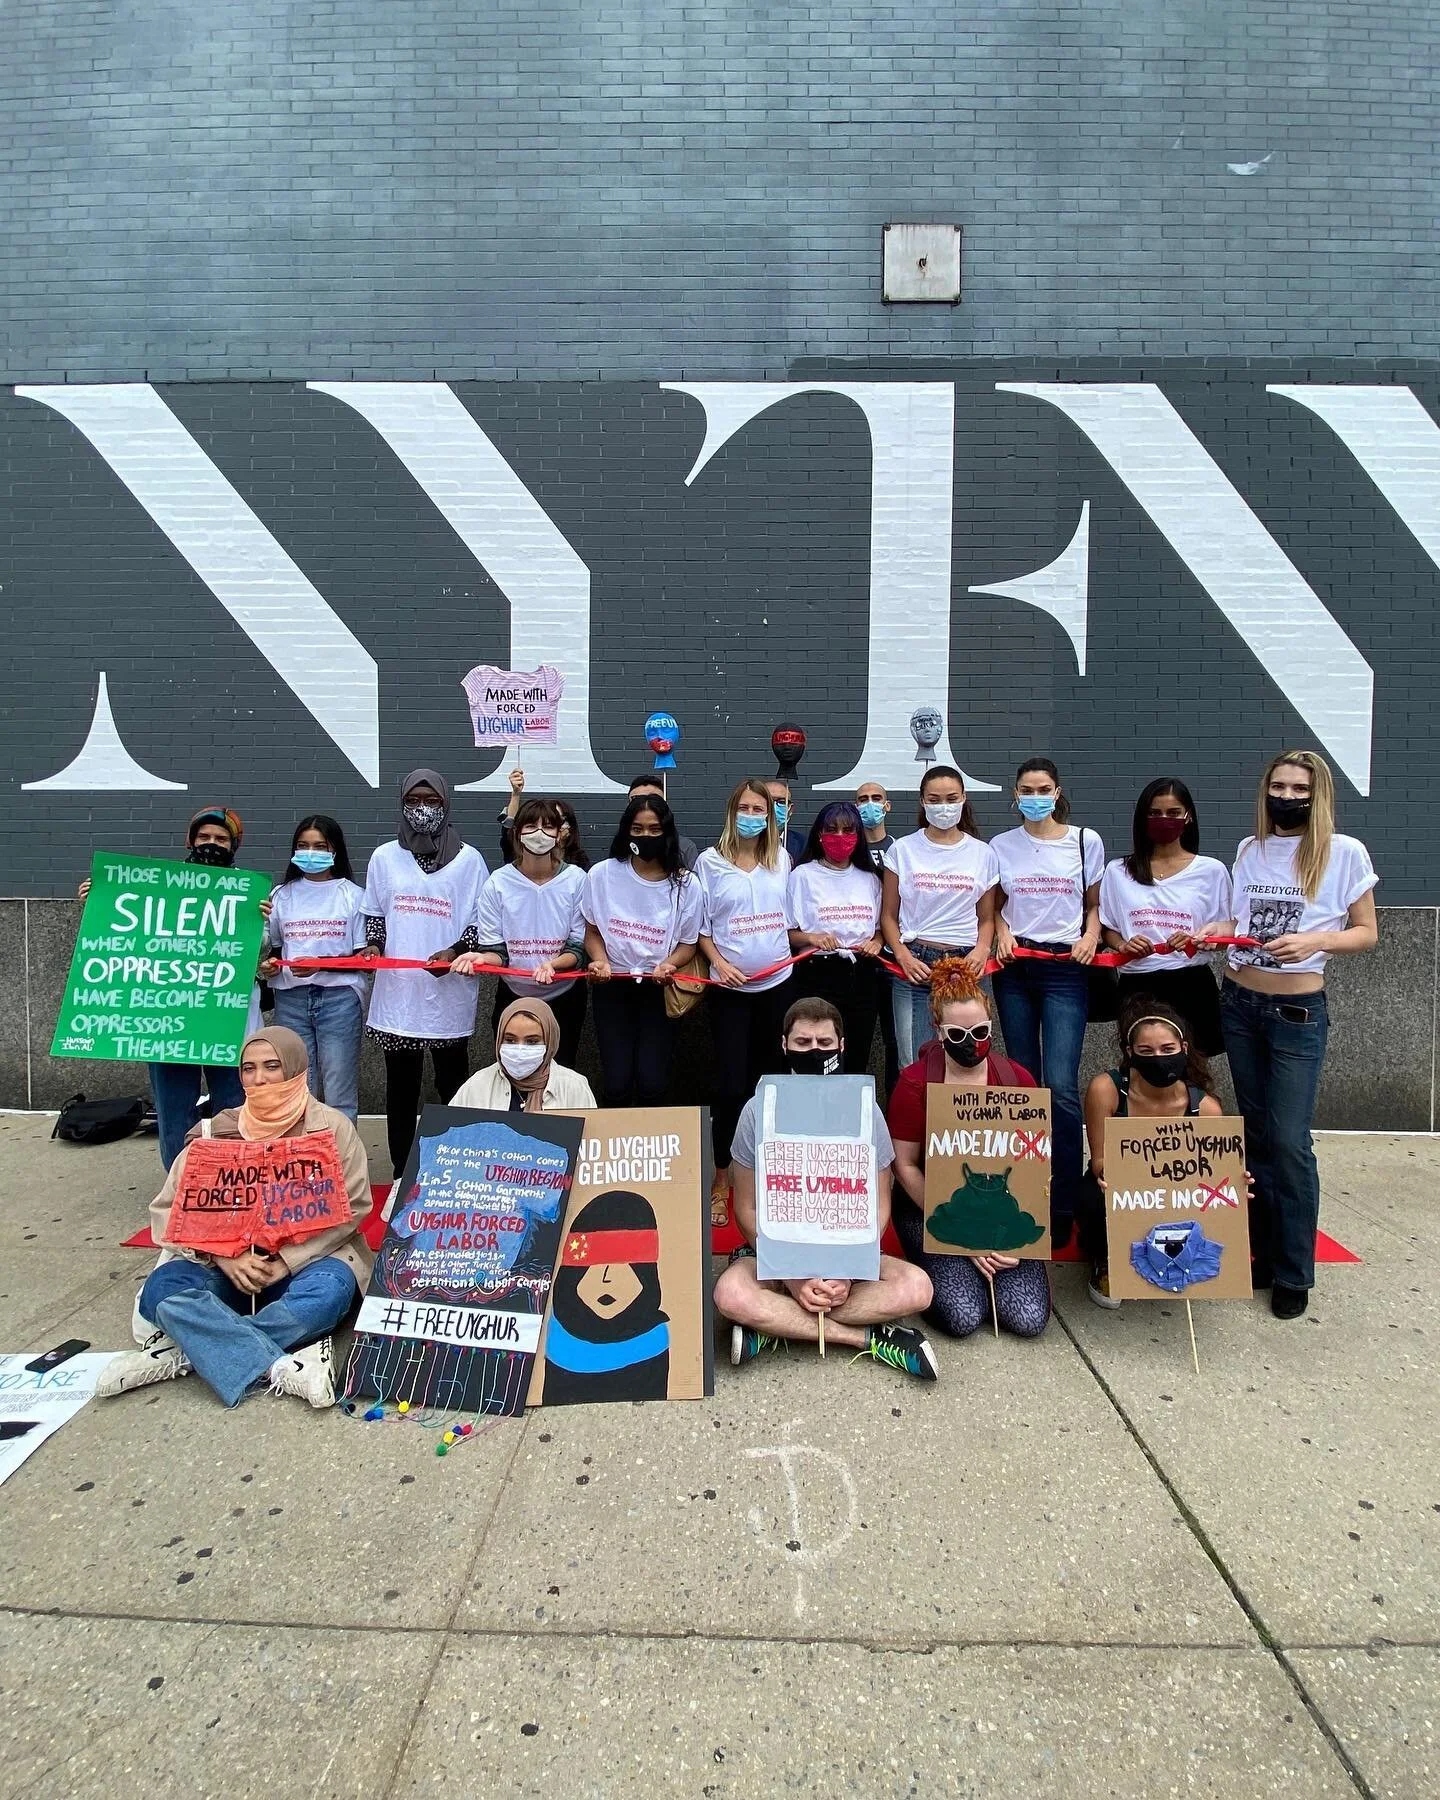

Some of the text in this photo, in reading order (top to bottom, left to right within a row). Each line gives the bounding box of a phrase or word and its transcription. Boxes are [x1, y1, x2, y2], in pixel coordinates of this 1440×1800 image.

[485, 687, 548, 702] MADE WITH
[497, 703, 536, 714] FORCED
[477, 716, 550, 735] UYGHUR LABOR
[104, 865, 251, 892] THOSE WHO ARE
[111, 892, 247, 936] SILENT
[82, 936, 244, 958] WHEN OTHERS ARE
[83, 957, 236, 988] OPPRESSED
[74, 988, 248, 1008] HAVE BECOME THE
[71, 1014, 185, 1035] OPPRESSORS
[111, 1037, 237, 1062] THEMSELVES
[953, 1091, 1030, 1106] WITH FORCED
[957, 1107, 1047, 1121] UYGHUR LABOR
[1156, 1121, 1193, 1136] WITH
[577, 1134, 681, 1161] ND UYGHUR
[764, 1142, 869, 1163] FREE UYGHUR
[929, 1129, 980, 1158] MADE
[982, 1129, 1009, 1158] IN
[1120, 1131, 1244, 1162] FORCED UYGHUR
[462, 1147, 499, 1158] China's
[502, 1151, 532, 1161] cotton
[537, 1156, 565, 1167] comes
[215, 1159, 323, 1187] MADE WITH
[419, 1171, 430, 1186] 1
[430, 1176, 440, 1184] in
[436, 1155, 573, 1190] from the UYGHUR REGION
[578, 1158, 673, 1185] GENOCIDE
[1151, 1156, 1212, 1182] LABOR
[183, 1179, 334, 1209] FORCED UYGHUR
[428, 1188, 436, 1197] in
[437, 1188, 452, 1198] the
[766, 1175, 868, 1194] FREE UYGHUR
[1112, 1188, 1167, 1211] MADE
[1172, 1187, 1190, 1209] IN
[266, 1198, 331, 1226] LABOR
[409, 1209, 527, 1233] UYGHUR FORCED
[767, 1205, 868, 1225] FREE UYGHUR
[436, 1231, 499, 1250] LABOR
[411, 1248, 425, 1259] An
[428, 1250, 475, 1260] estimated
[484, 1276, 515, 1290] labor
[517, 1278, 551, 1292] camps
